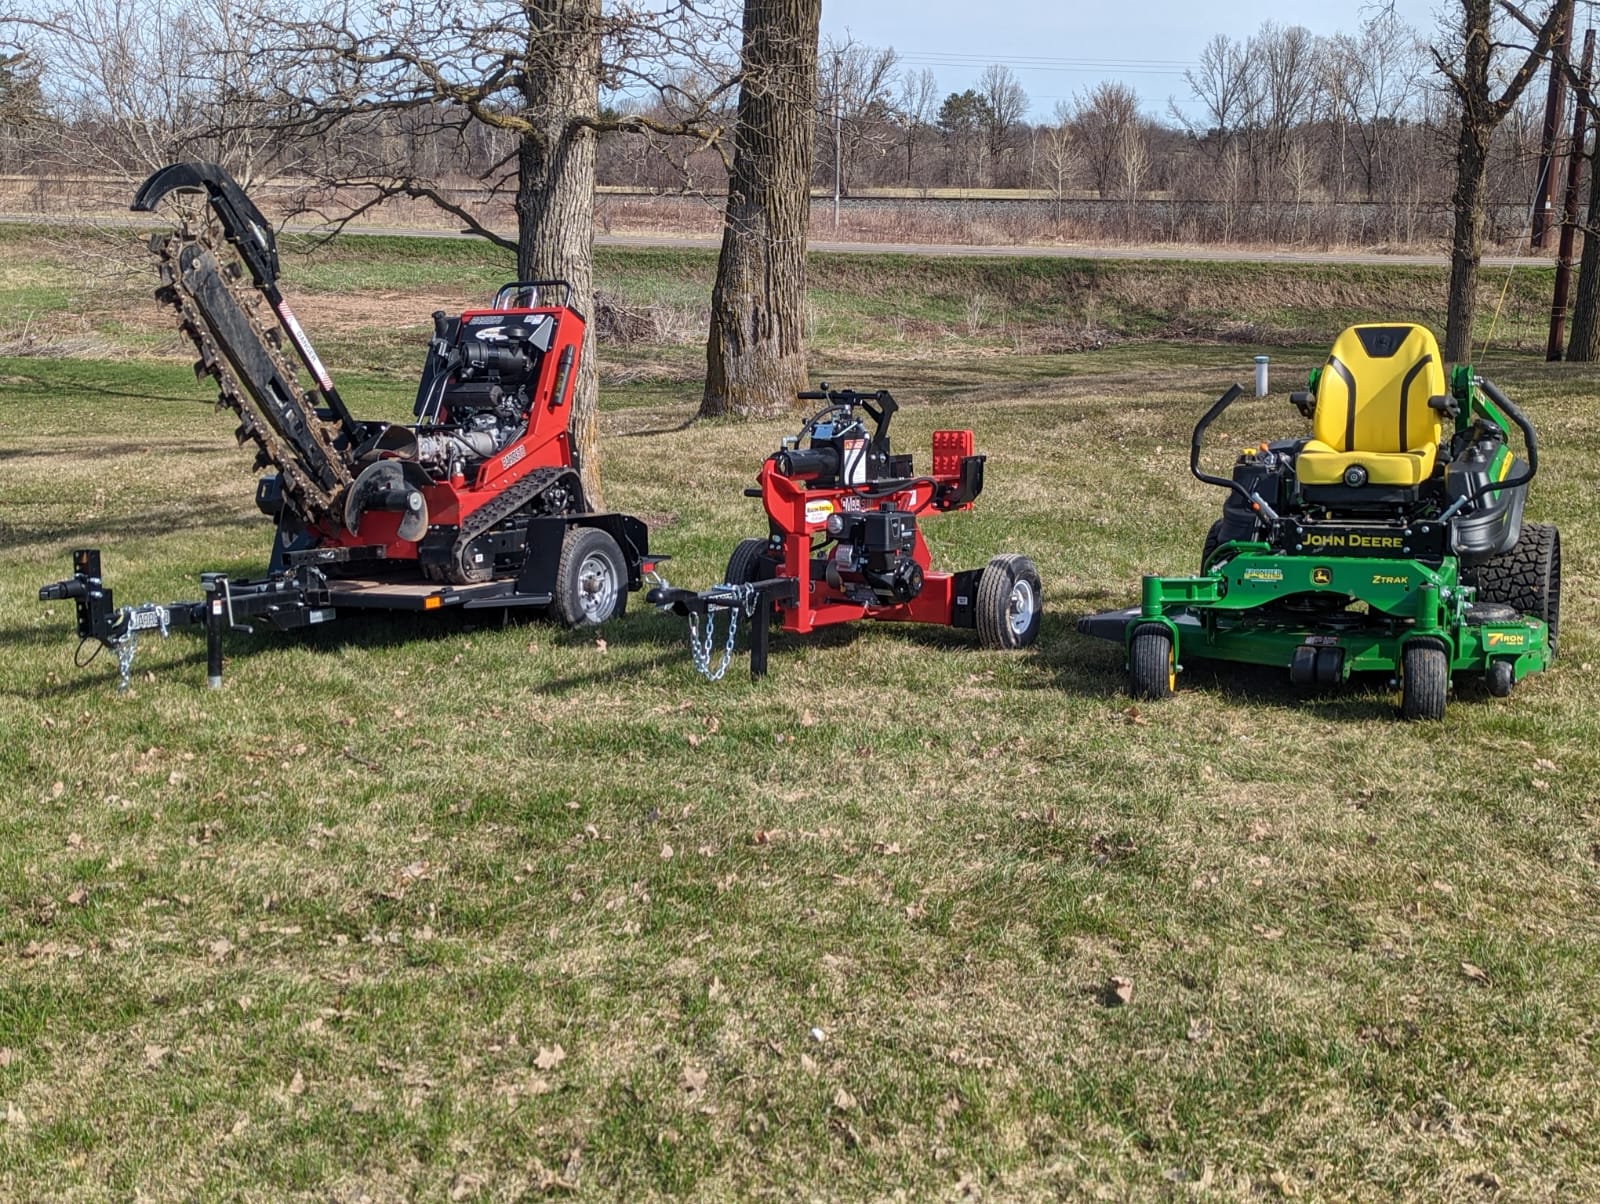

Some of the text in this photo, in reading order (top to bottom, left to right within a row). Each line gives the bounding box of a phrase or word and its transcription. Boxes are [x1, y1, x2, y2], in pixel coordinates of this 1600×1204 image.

[296, 330, 317, 362] DANGER
[1302, 533, 1403, 548] JOHN DEERE
[1372, 575, 1408, 584] ZTRAK
